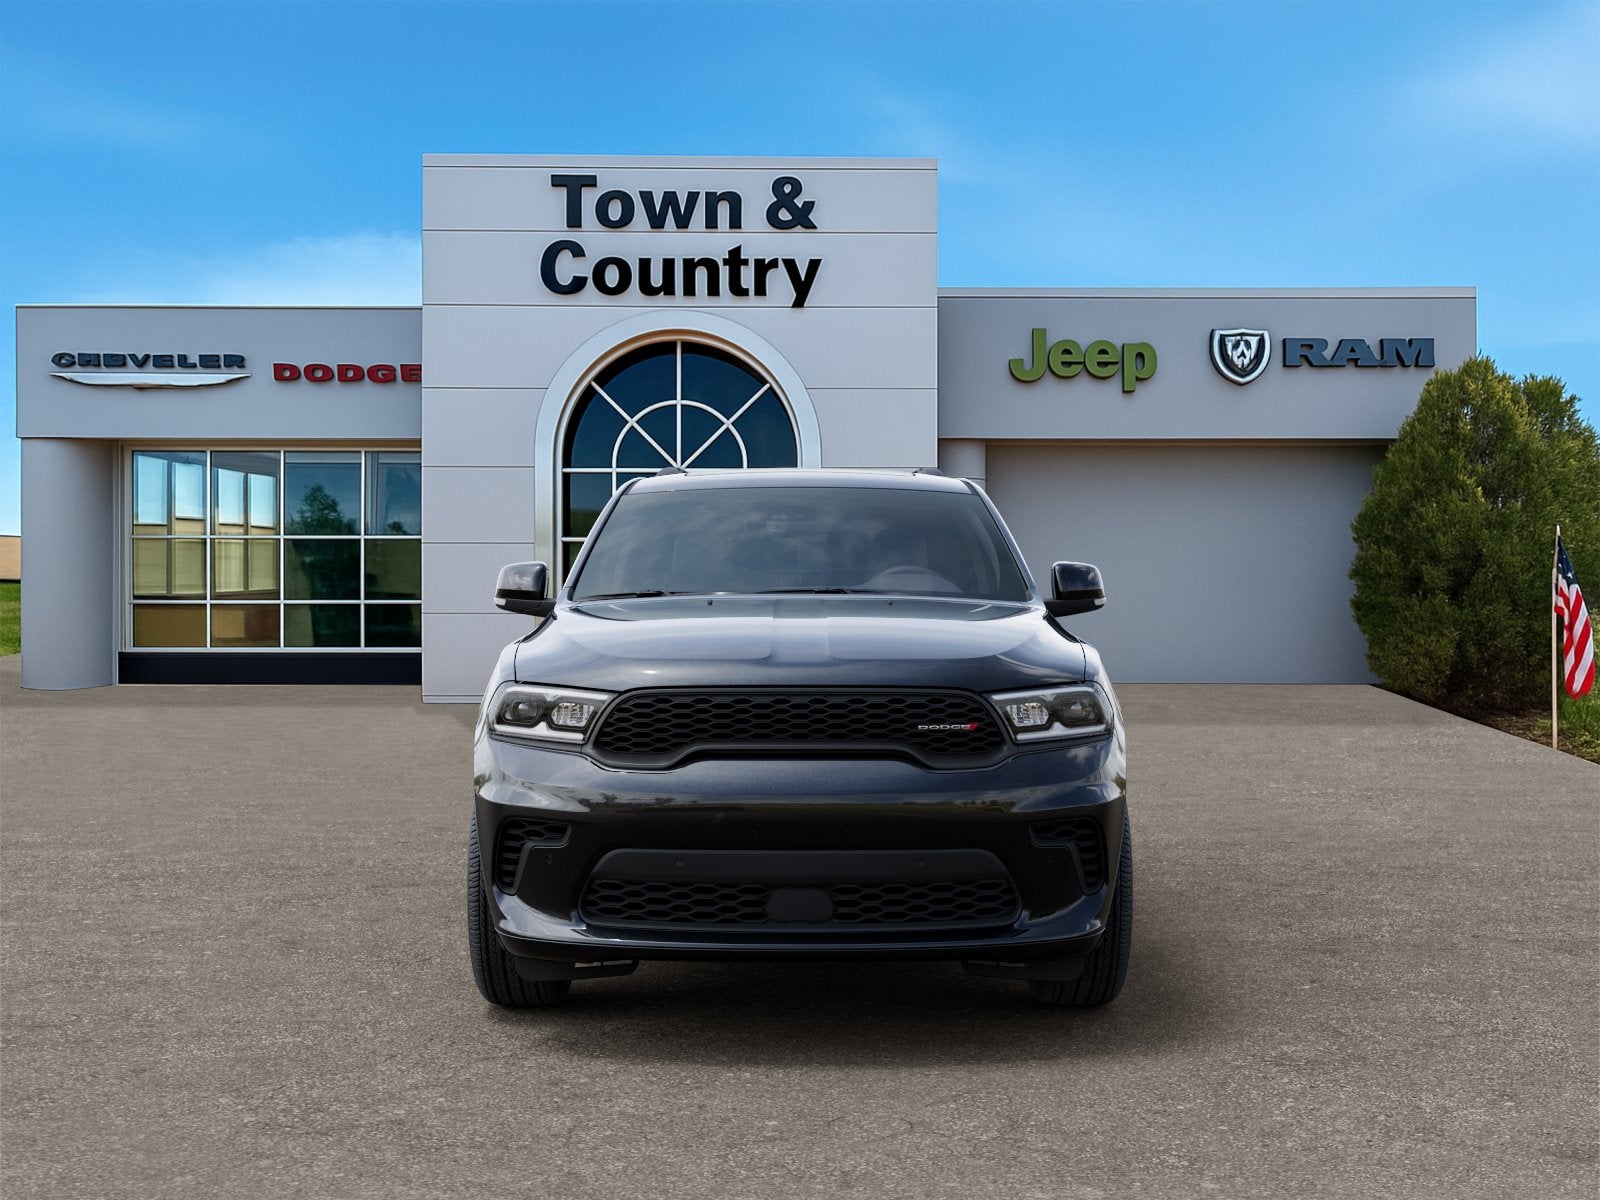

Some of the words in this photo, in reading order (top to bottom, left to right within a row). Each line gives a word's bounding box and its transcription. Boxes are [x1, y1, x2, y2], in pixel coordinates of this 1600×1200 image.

[550, 174, 743, 230] Town
[765, 175, 818, 230] &
[539, 239, 823, 308] Country
[273, 362, 422, 384] DODGE
[1009, 327, 1157, 393] Jeep
[1282, 337, 1436, 368] RAM
